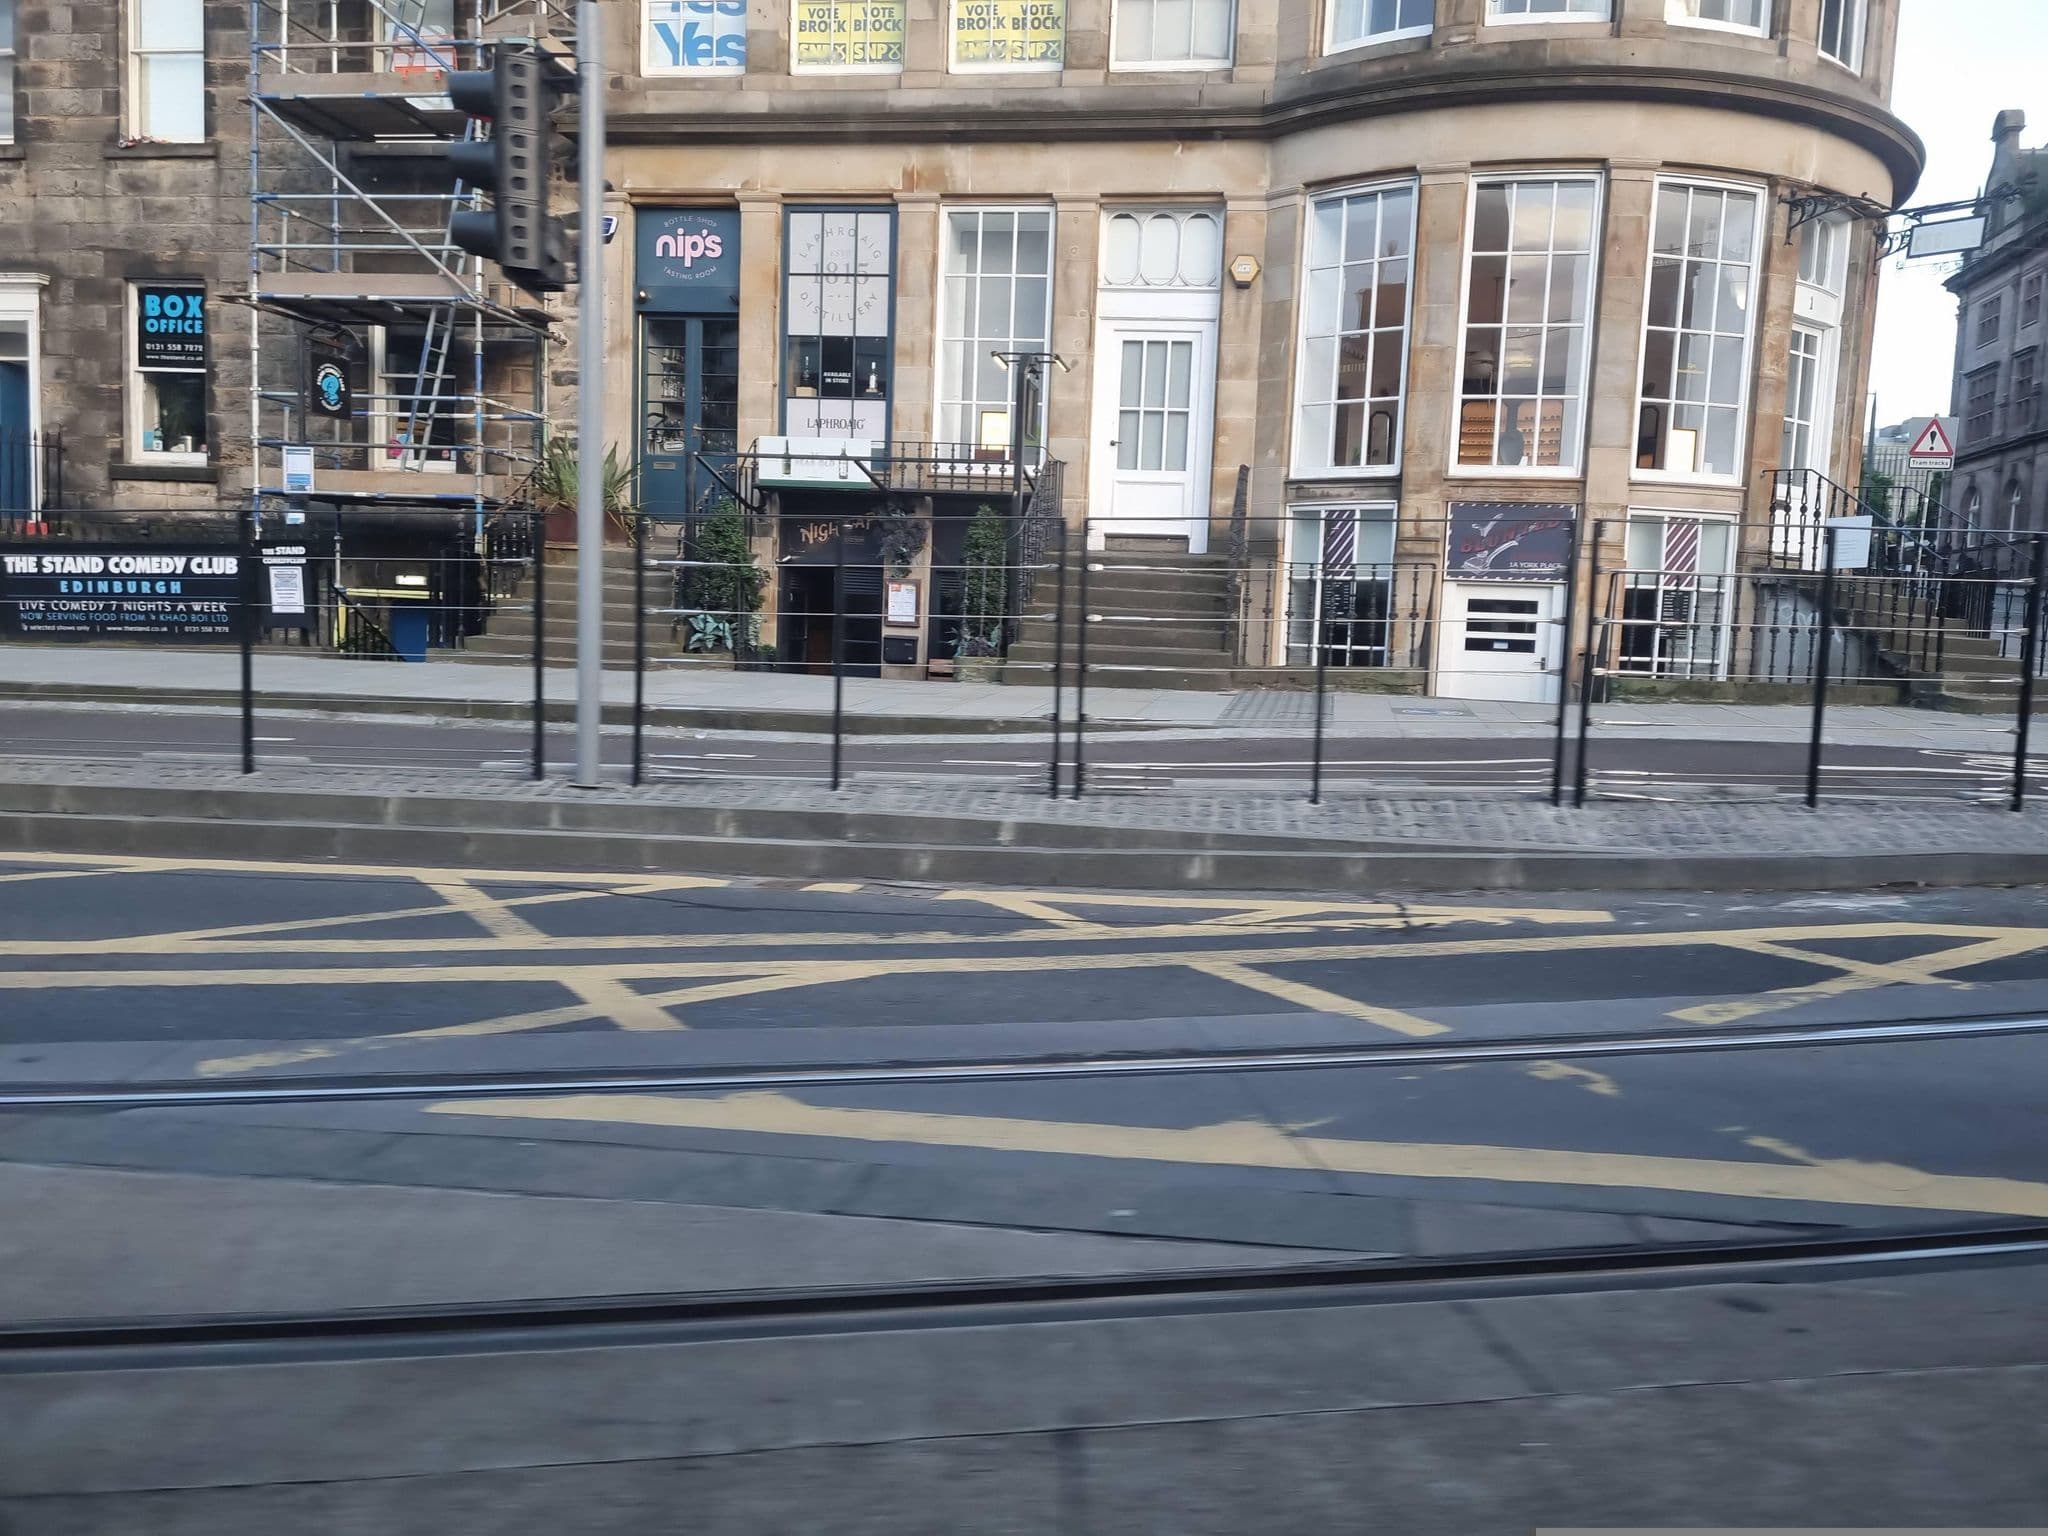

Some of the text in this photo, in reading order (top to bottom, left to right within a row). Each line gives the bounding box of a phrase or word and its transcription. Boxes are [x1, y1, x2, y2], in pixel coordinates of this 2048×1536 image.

[808, 8, 839, 19] VOTE
[862, 7, 895, 18] VOTE
[966, 4, 998, 16] VOTE
[1021, 4, 1053, 16] VOTE
[799, 20, 847, 32] BROCK
[853, 19, 902, 31] BROCK
[957, 16, 1006, 30] BROCK
[1012, 16, 1061, 30] BROCK
[653, 22, 746, 66] Yes
[853, 43, 888, 60] SNP
[664, 215, 718, 228] BOTTLE SHOP
[655, 227, 723, 268] nip's
[799, 226, 882, 260] LAPHROAIG
[664, 265, 717, 280] TASTING ROOM
[811, 262, 869, 285] 1815
[145, 294, 204, 318] BOX
[800, 291, 878, 323] DISTILLERY
[145, 318, 204, 334] OFFICE
[145, 343, 165, 351] 0131
[275, 545, 306, 555] STAND
[3, 556, 239, 575] THE STAND COMEDY CLUB
[60, 580, 182, 594] EDINBURGH
[19, 600, 227, 613] LIVE COMEDY 7 NIGHTS A WEEK
[20, 612, 43, 620] NOW
[46, 612, 87, 621] SERVING
[89, 612, 117, 621] FOOD
[120, 613, 145, 622] FROM
[159, 613, 188, 622] KHAO
